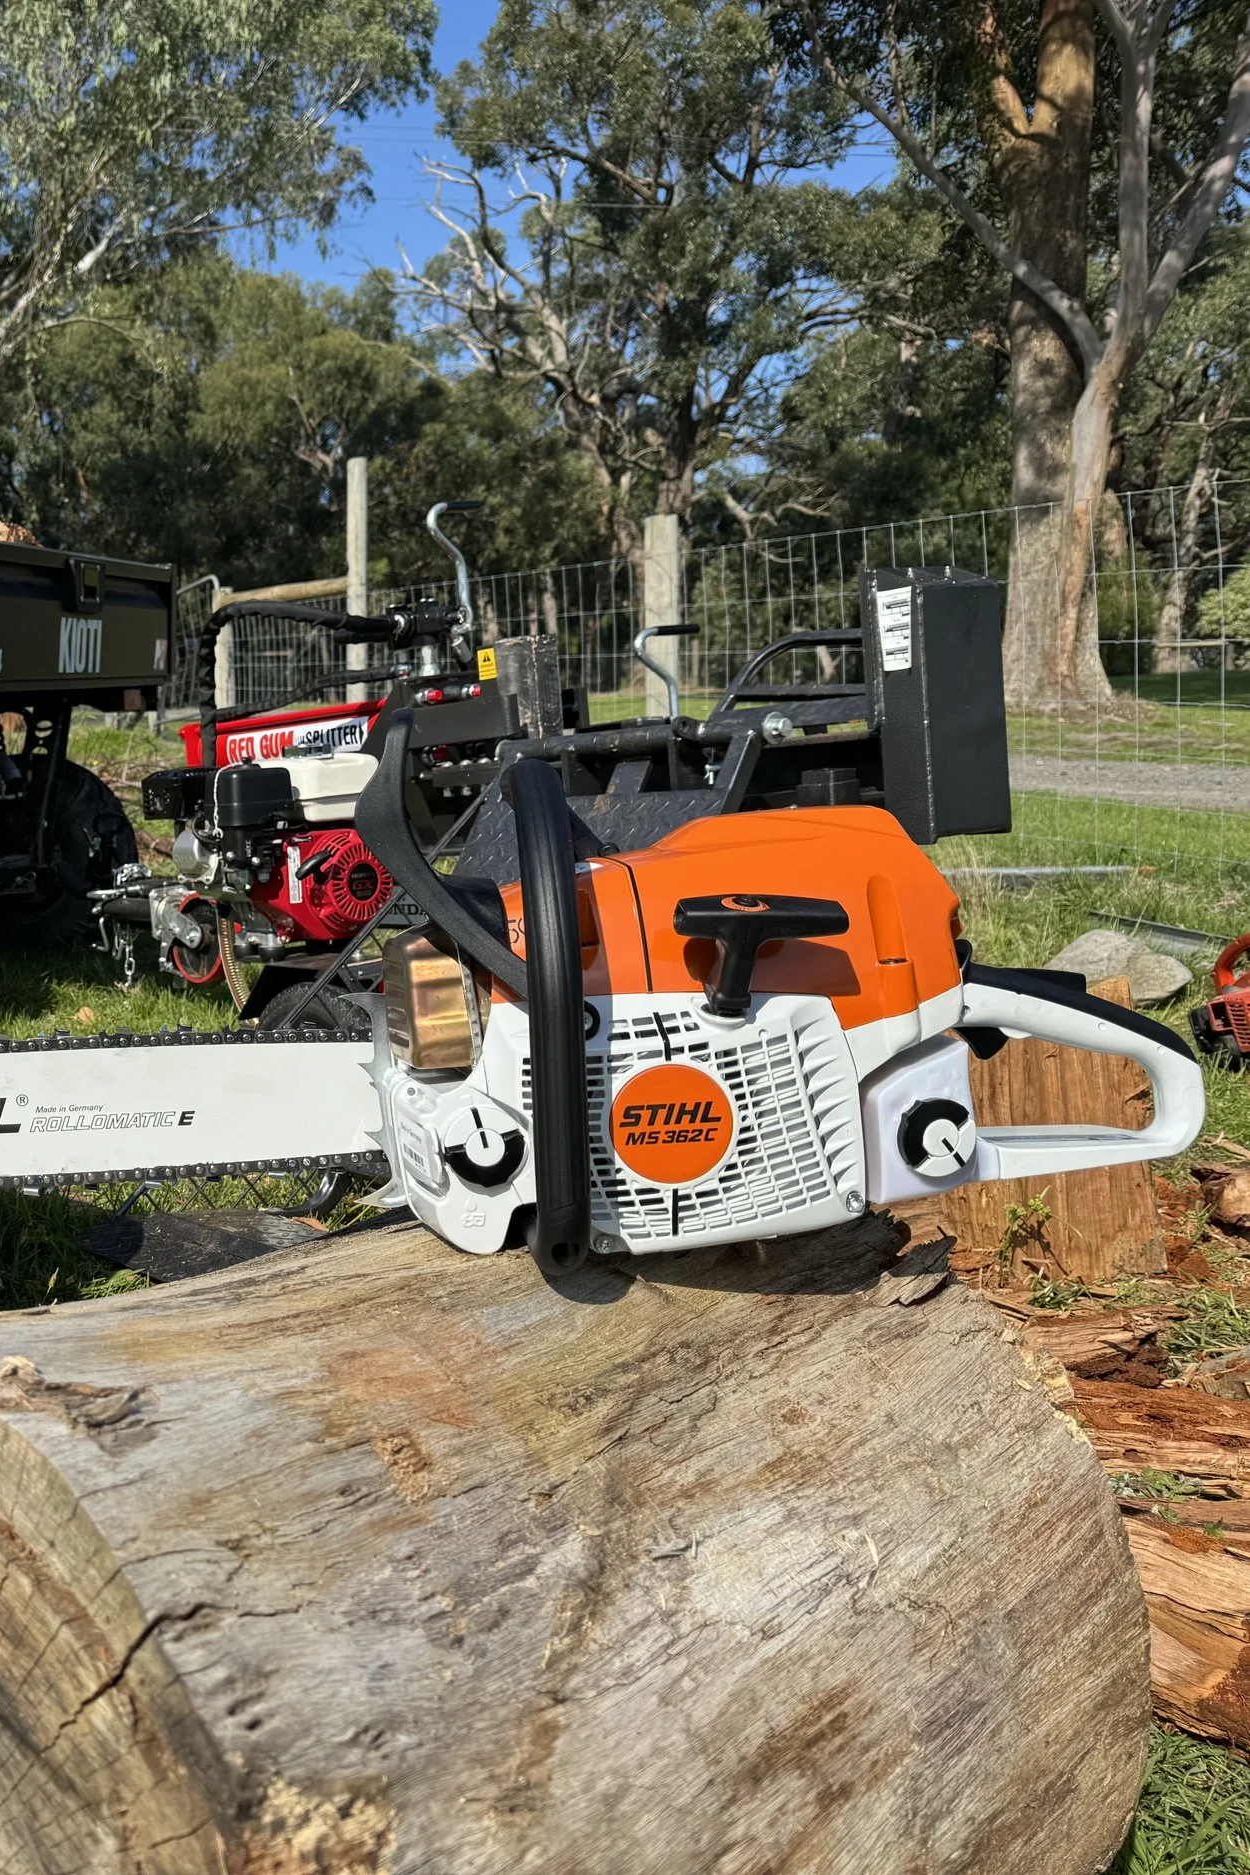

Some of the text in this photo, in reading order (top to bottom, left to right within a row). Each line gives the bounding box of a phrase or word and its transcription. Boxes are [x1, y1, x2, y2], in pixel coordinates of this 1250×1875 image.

[58, 617, 102, 673] KIOTI
[228, 737, 256, 763] RED
[260, 731, 294, 760] GUM
[305, 724, 358, 748] SPLITTER
[30, 1110, 196, 1133] ROLLOMATIC E
[35, 1105, 57, 1114] Made
[58, 1105, 67, 1113] in
[68, 1103, 104, 1114] Germany
[619, 1101, 722, 1128] STIHL
